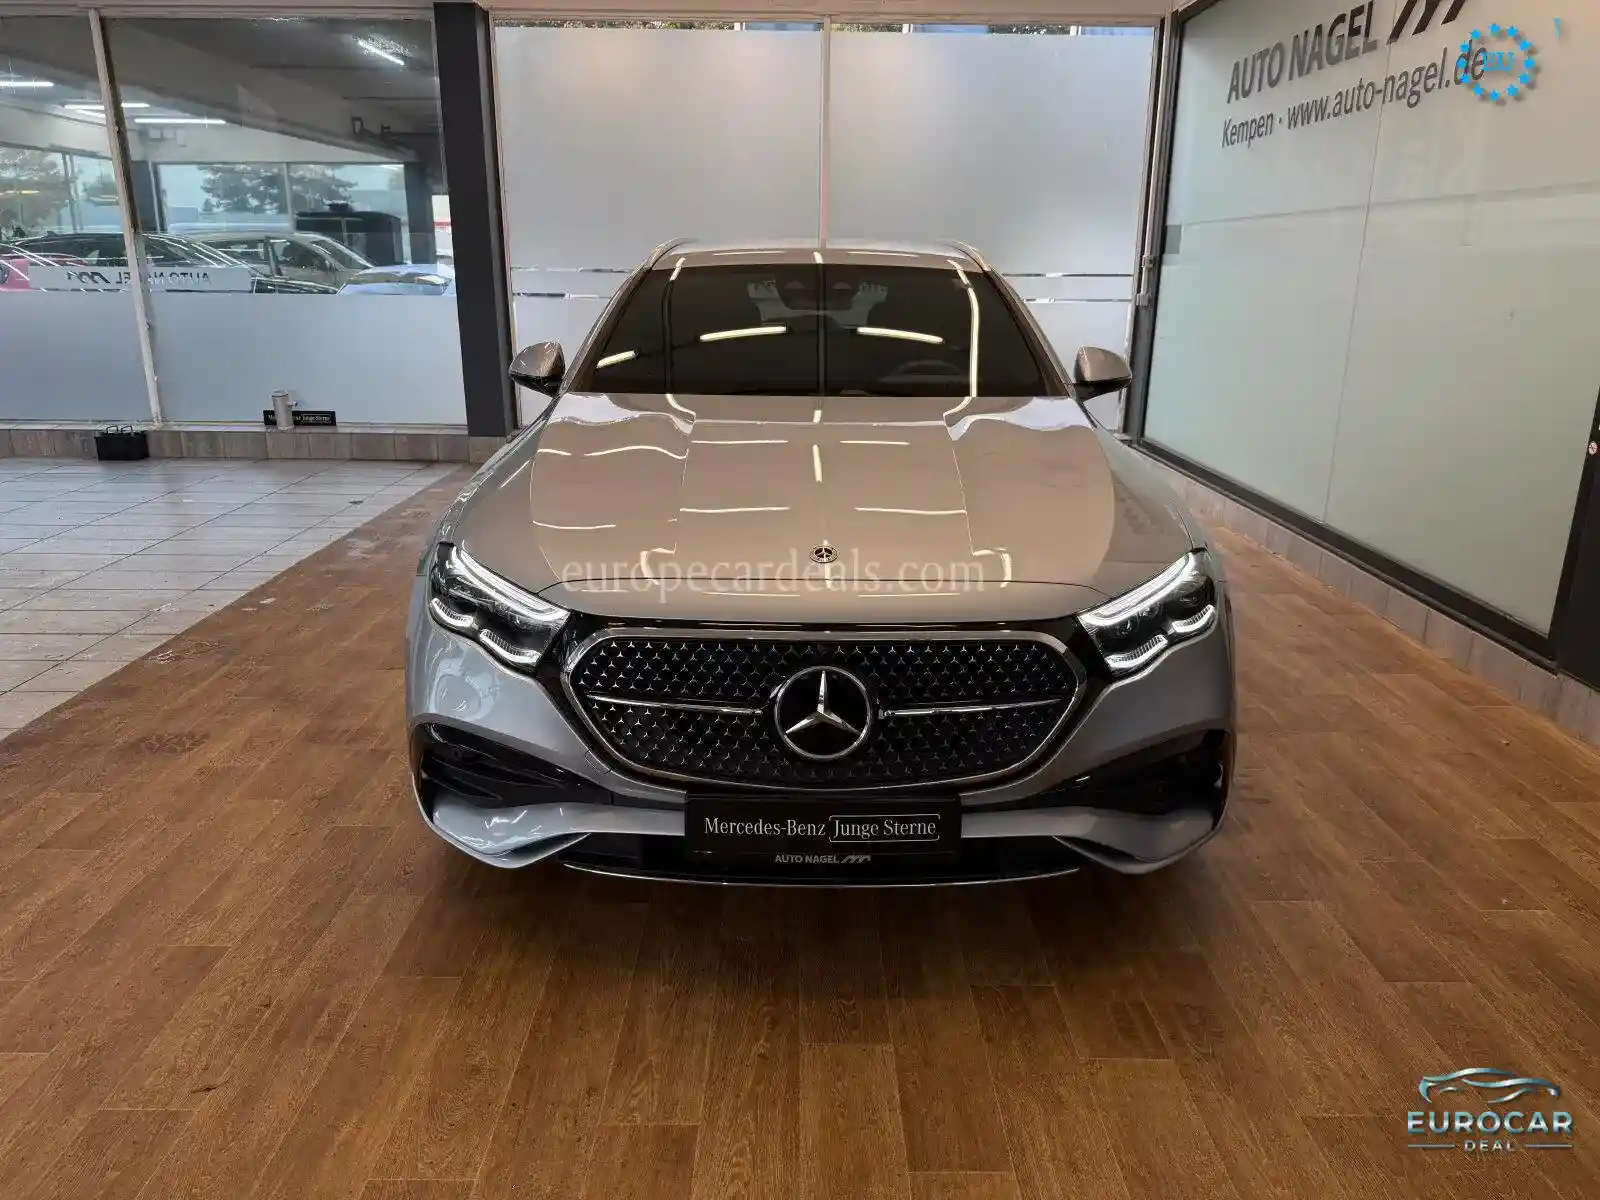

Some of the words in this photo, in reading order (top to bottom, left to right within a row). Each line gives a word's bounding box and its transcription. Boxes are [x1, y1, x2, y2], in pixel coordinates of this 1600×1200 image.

[1227, 41, 1285, 104] AUTO
[1288, 1, 1378, 81] NAGEL
[1221, 112, 1274, 149] Kempen
[1287, 38, 1488, 130] www.auto-nagel.de
[704, 817, 826, 836] Mercedes-Benz
[833, 819, 880, 840] Junge
[883, 819, 937, 836] Sterne
[774, 854, 803, 864] AUTO
[805, 854, 840, 864] NAGEL
